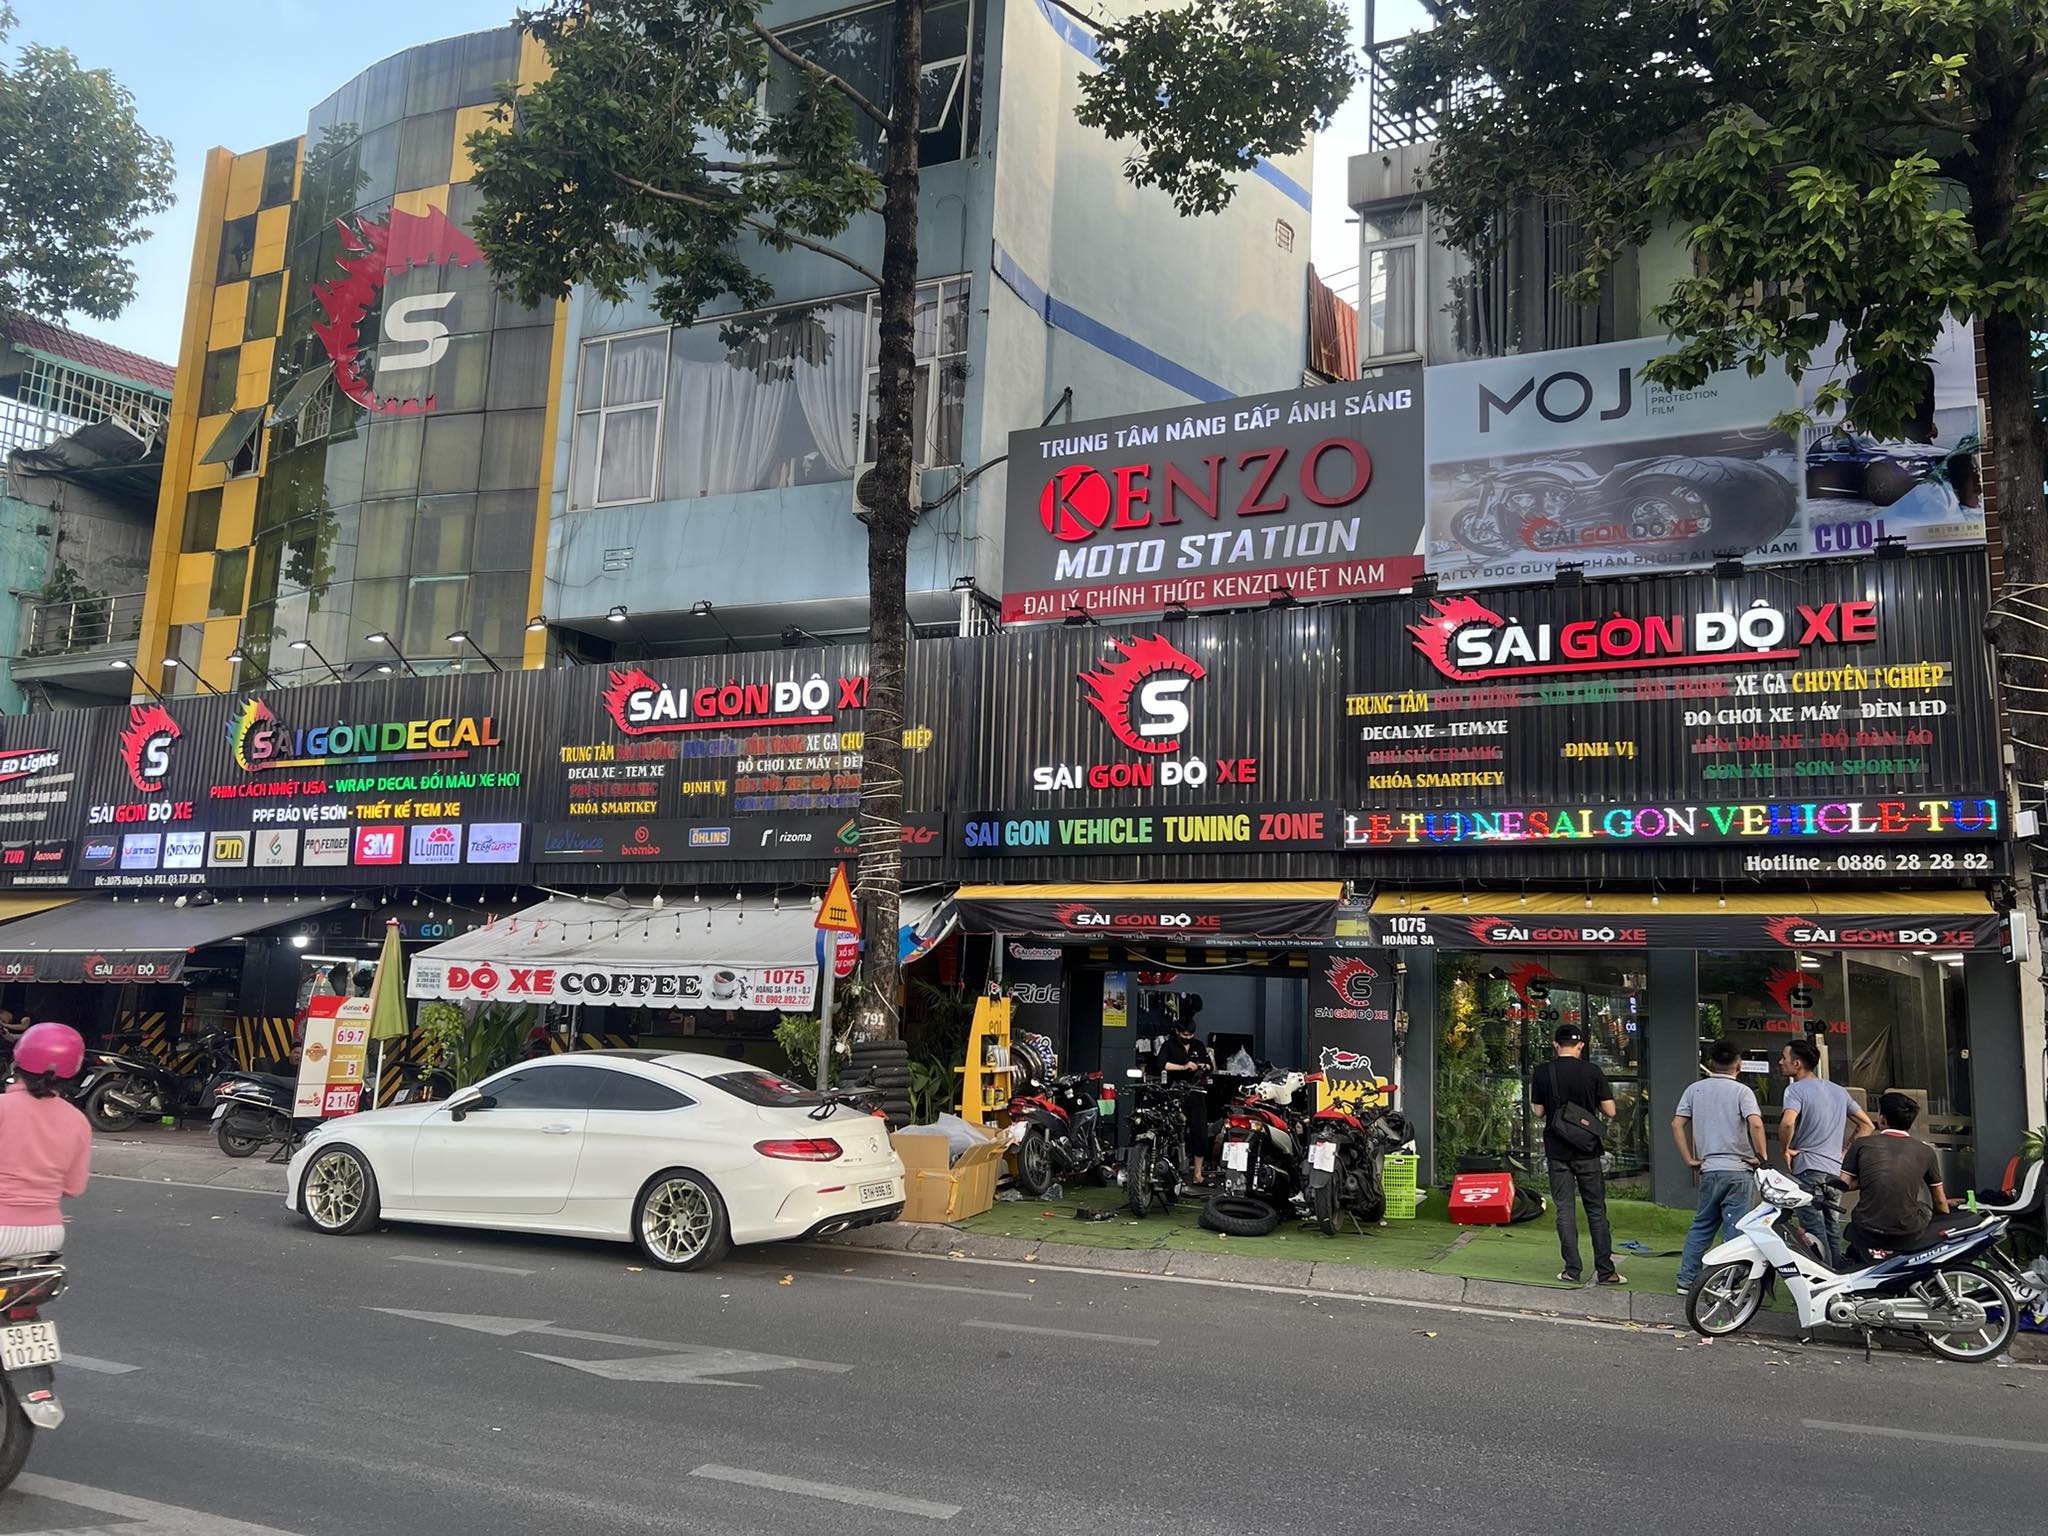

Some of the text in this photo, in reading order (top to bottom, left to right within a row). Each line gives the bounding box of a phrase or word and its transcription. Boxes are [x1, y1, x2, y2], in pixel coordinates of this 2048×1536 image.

[379, 291, 456, 371] S
[1479, 367, 1632, 433] MOJ
[1651, 390, 1718, 405] PROTECTION
[1652, 405, 1675, 416] FILM
[1040, 389, 1411, 459] TRUNG TÂM NÂNG CẤP ÁNH SÁNG
[1039, 437, 1372, 541] KENZO
[1054, 517, 1361, 581] MOTO STATION
[1756, 542, 1799, 556] NAM
[1024, 564, 1385, 617] ĐẠI LÝ CHÍNH THỨC KENZO VIỆT NAM
[1457, 599, 1877, 667] SÀI GÒN ĐỘ XE
[629, 673, 830, 722] SÀI GÒN ĐỘ
[1346, 695, 1393, 716] TRUNG
[1399, 689, 1429, 714] TÂM
[1735, 674, 1758, 697] XE
[1763, 673, 1787, 695] GA
[1792, 664, 1868, 693] CHUYÊN
[1141, 678, 1190, 736] S
[1717, 700, 1947, 725] CHƠI XE MÁY ĐÈN LED
[1363, 720, 1508, 741] DECAL XE TEM XE
[560, 746, 592, 762] TRUNG
[594, 741, 615, 762] TÂM
[806, 735, 820, 751] XE
[823, 734, 838, 750] GA
[1565, 741, 1634, 761] ĐỊNH VỊ
[1778, 733, 1803, 750] XE
[20, 753, 59, 773] Lights
[144, 737, 173, 777] S
[757, 757, 784, 771] CHƠI
[787, 758, 802, 770] XE
[806, 752, 832, 769] MÁY
[1429, 746, 1501, 762] CERAMIC
[568, 765, 665, 780] DECAL XE TEM XE
[1033, 755, 1257, 790] SÀI GÒN ĐỘ XE
[1750, 761, 1773, 778] XE
[1841, 758, 1921, 775] SPORTY
[209, 785, 237, 799] PHIM
[238, 782, 266, 797] CÁCH
[268, 779, 300, 797] NHIỆT
[302, 780, 326, 794] USA
[335, 778, 374, 793] WRAP
[377, 775, 418, 791] DECAL
[446, 771, 476, 788] MÀU
[479, 772, 495, 788] XE
[682, 781, 711, 798] ĐỊNH
[713, 780, 727, 798] VỊ
[1369, 771, 1504, 789] KHÓA SMARTKEY
[89, 799, 193, 824] SÀI GÒN ĐỘ XE
[253, 808, 276, 822] PPF
[302, 804, 319, 823] VỆ
[320, 804, 347, 820] SƠN
[355, 799, 392, 819] THIẾT
[413, 802, 441, 818] TEM
[443, 802, 461, 817] XE
[570, 800, 657, 815] KHÓA SMARTKEY
[1603, 801, 1908, 838] GON VEHICLE
[779, 831, 812, 842] rizoma
[965, 822, 999, 848] SAI
[1005, 820, 1049, 846] GON
[1058, 817, 1152, 845] VEHICLE
[1163, 814, 1250, 843] TUNING
[1258, 812, 1324, 841] ZONE
[167, 843, 201, 857] KENZO
[363, 832, 395, 855] 3M
[621, 844, 661, 856] brembo
[1747, 853, 1988, 871] Hotline 0886 28 28 82
[1076, 911, 1221, 928] SÀI GÒN ĐỘ XE
[1390, 917, 1426, 933] 1075
[1382, 932, 1434, 945] HOÀNG SA
[1492, 926, 1647, 943] SÀI GÒN ĐỘ XE
[1793, 926, 1974, 945] SÀI GÒN ĐỘ XE
[94, 962, 170, 977] SÀI ĐỘ XE
[447, 960, 500, 999] ĐỘ
[507, 968, 556, 994] XE
[560, 972, 703, 998] COFFEE
[763, 969, 805, 985] 1075
[863, 1012, 885, 1026] 791
[1315, 1006, 1389, 1021] SÀI GÒN ĐỘ XE
